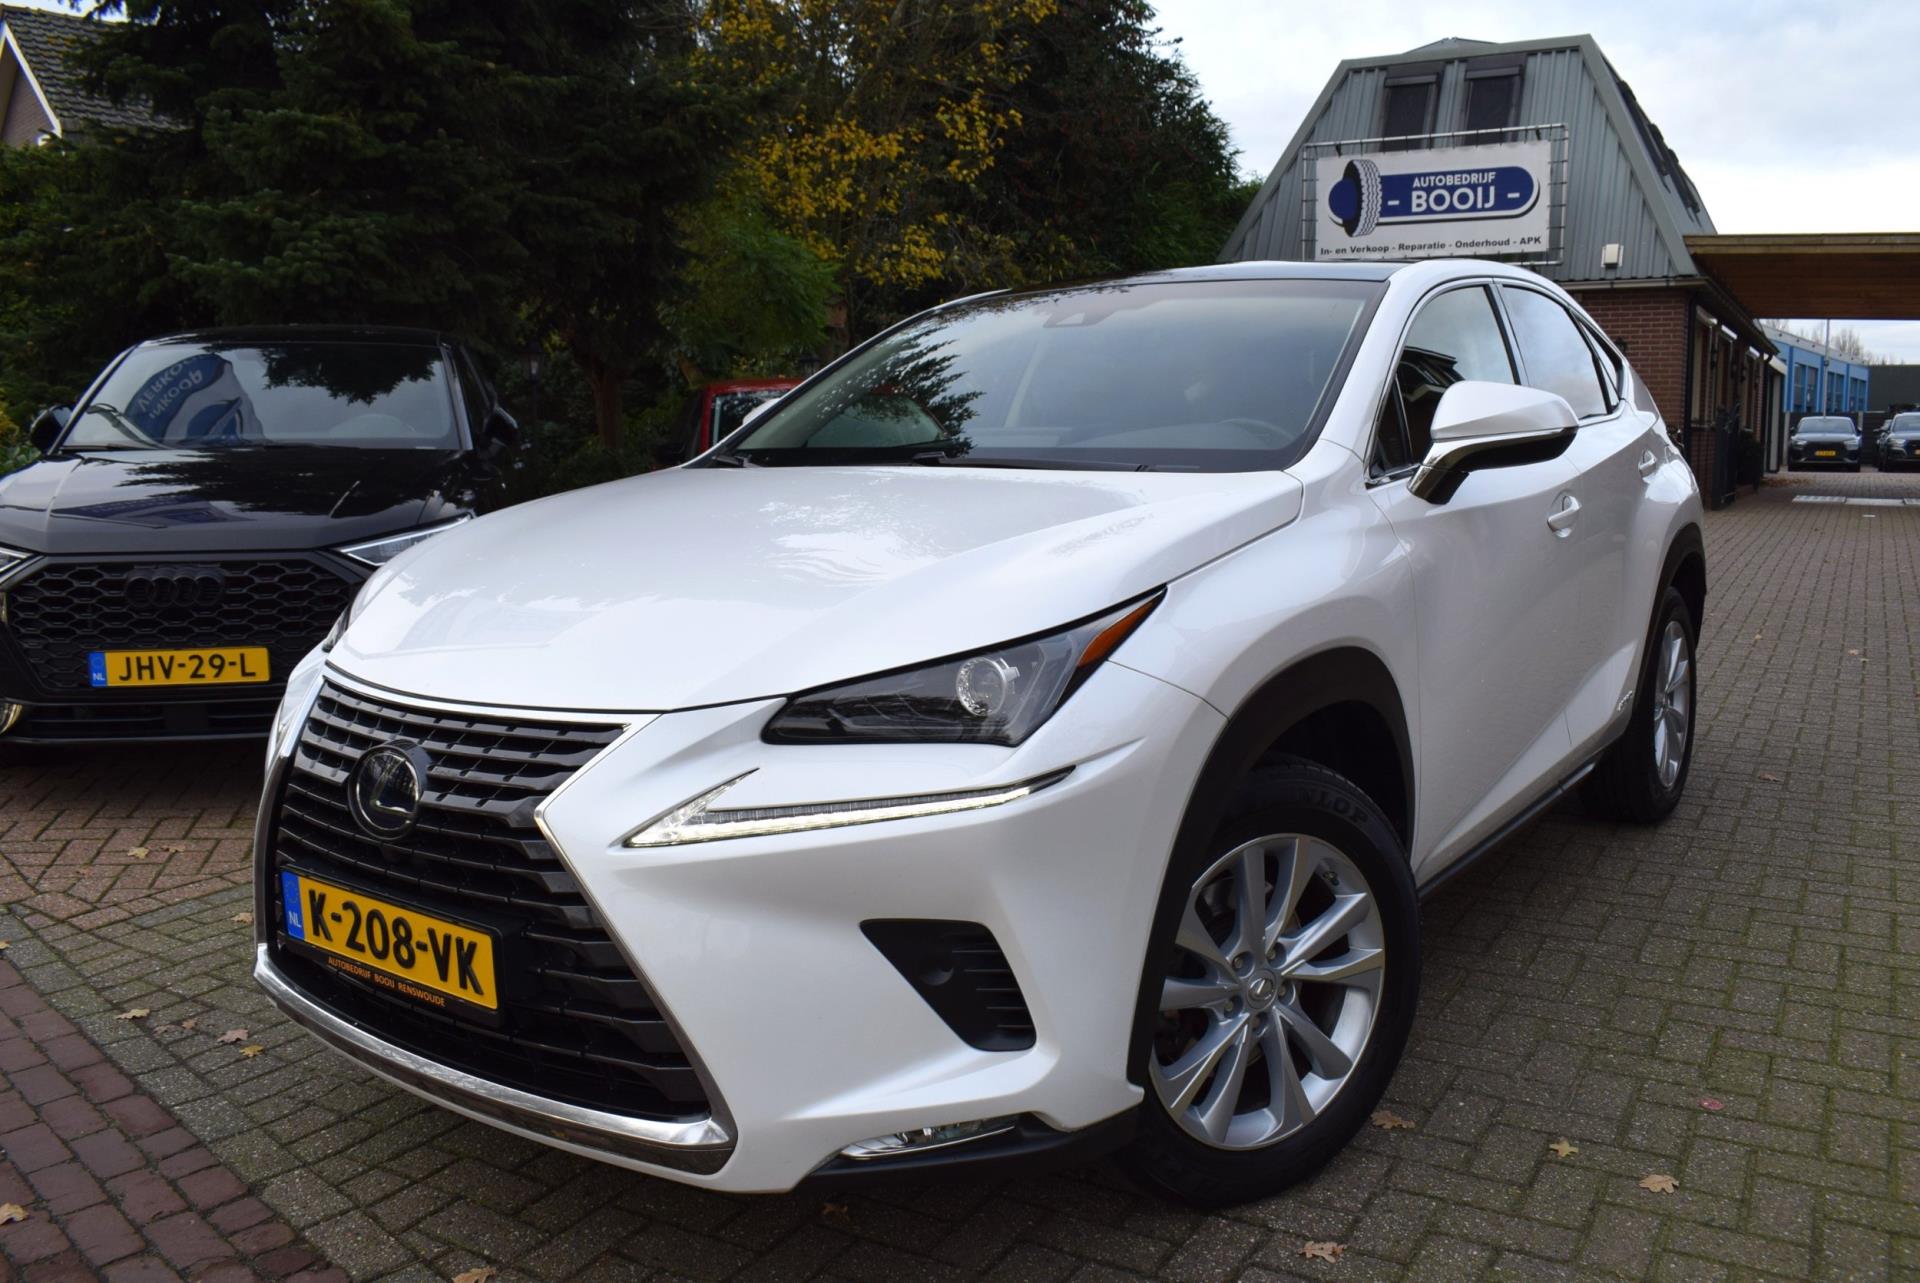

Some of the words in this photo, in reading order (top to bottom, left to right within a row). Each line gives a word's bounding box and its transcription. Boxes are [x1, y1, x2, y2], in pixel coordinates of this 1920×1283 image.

[1412, 171, 1497, 188] AUTOBEDRIJF
[1410, 185, 1496, 213] BOOIJ
[1320, 247, 1333, 255] In-
[1350, 244, 1389, 254] Verkoop
[1398, 240, 1446, 252] Reparatie
[1455, 238, 1511, 249] Onderhoud
[1519, 236, 1542, 245] APK
[92, 673, 106, 681] NL
[119, 653, 257, 682] JHV-29-L
[288, 911, 302, 929] NL
[308, 888, 485, 996] K-208-VK
[397, 982, 446, 1007] RENSWOUDE
